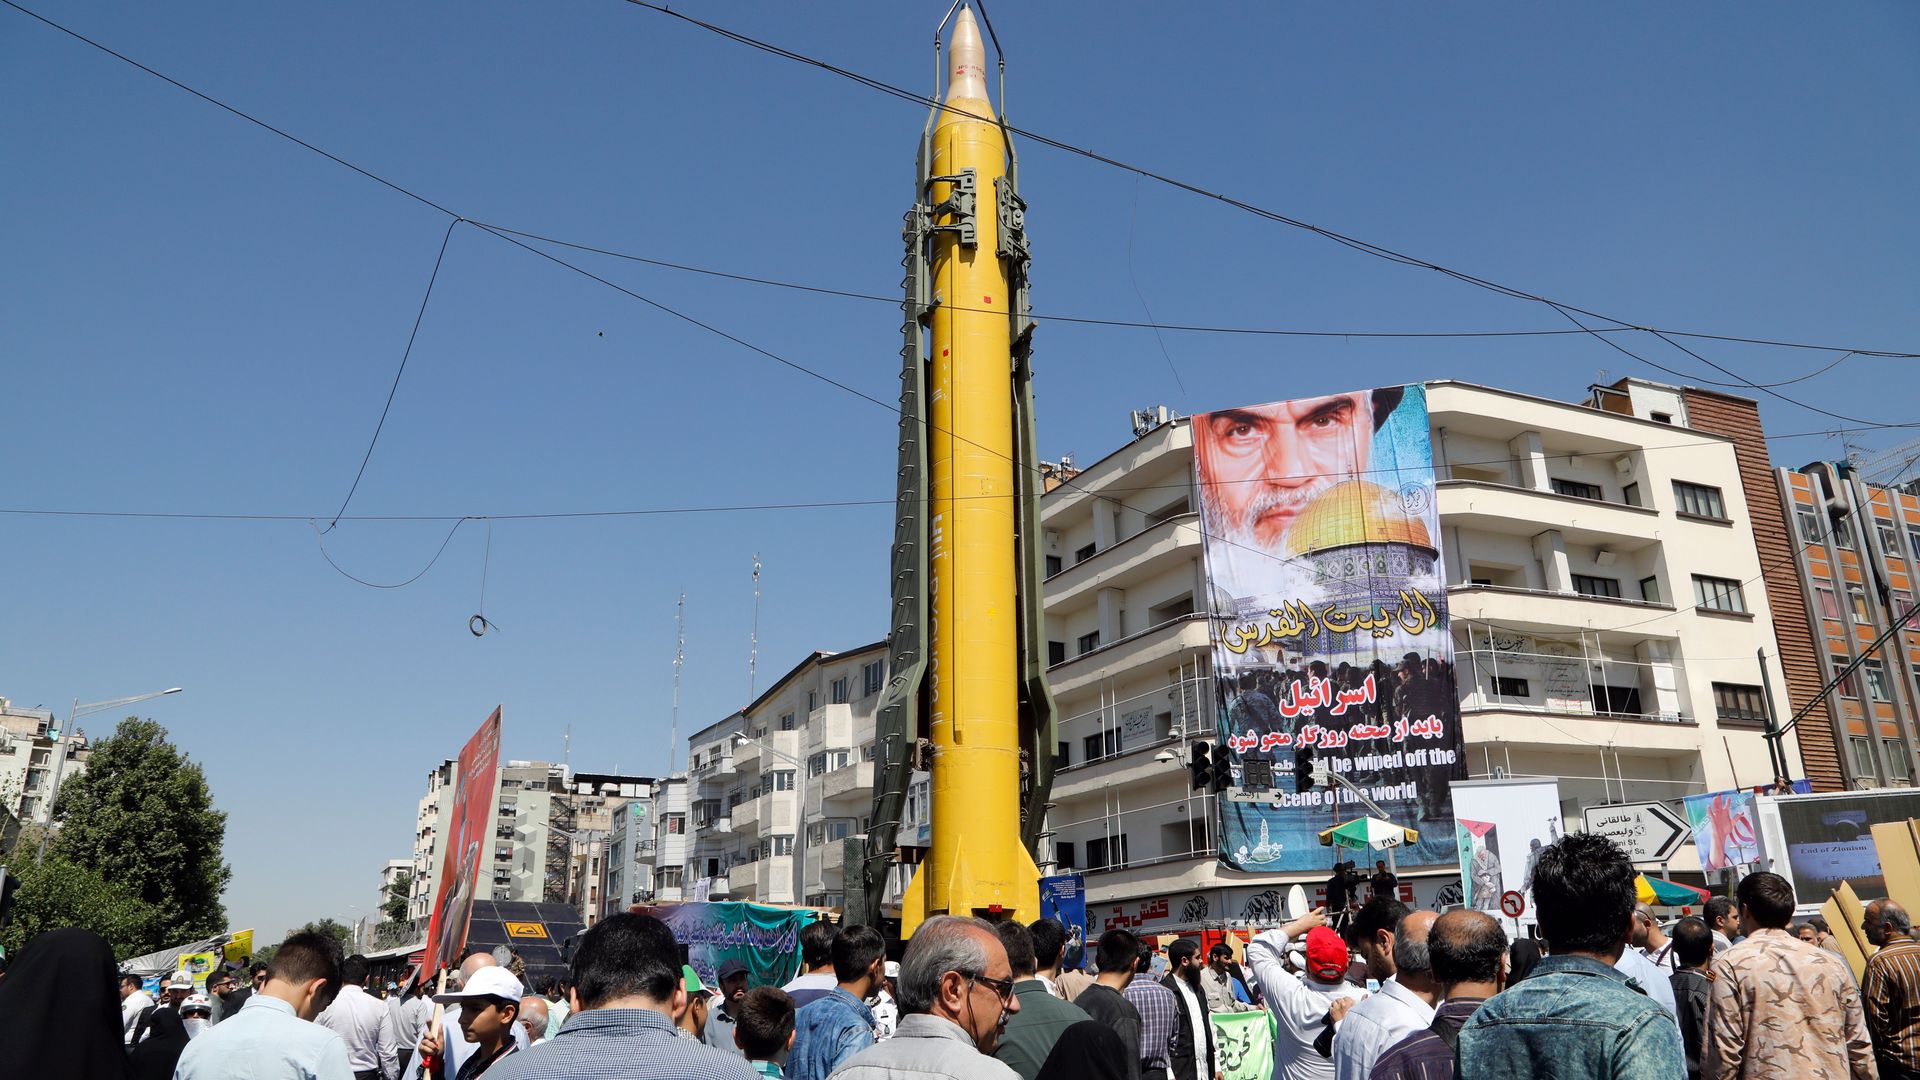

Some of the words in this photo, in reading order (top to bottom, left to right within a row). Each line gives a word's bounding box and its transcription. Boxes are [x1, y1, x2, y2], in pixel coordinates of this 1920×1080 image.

[1222, 599, 1320, 654] المقدس
[1322, 604, 1394, 638] بیت
[1280, 674, 1377, 718] اسرائیل
[1294, 724, 1348, 749] روزگار
[1349, 723, 1391, 740] صحنه
[1392, 717, 1409, 742] از
[1411, 714, 1443, 739] باید
[1260, 731, 1292, 752] محو
[1332, 756, 1352, 773] be
[1354, 751, 1403, 771] wiped
[1405, 749, 1428, 767] off
[1429, 748, 1456, 765] the
[1325, 787, 1341, 805] of
[1342, 786, 1369, 803] the
[1371, 781, 1418, 801] world
[1597, 814, 1631, 827] طالقانی
[1381, 836, 1397, 848] PAS
